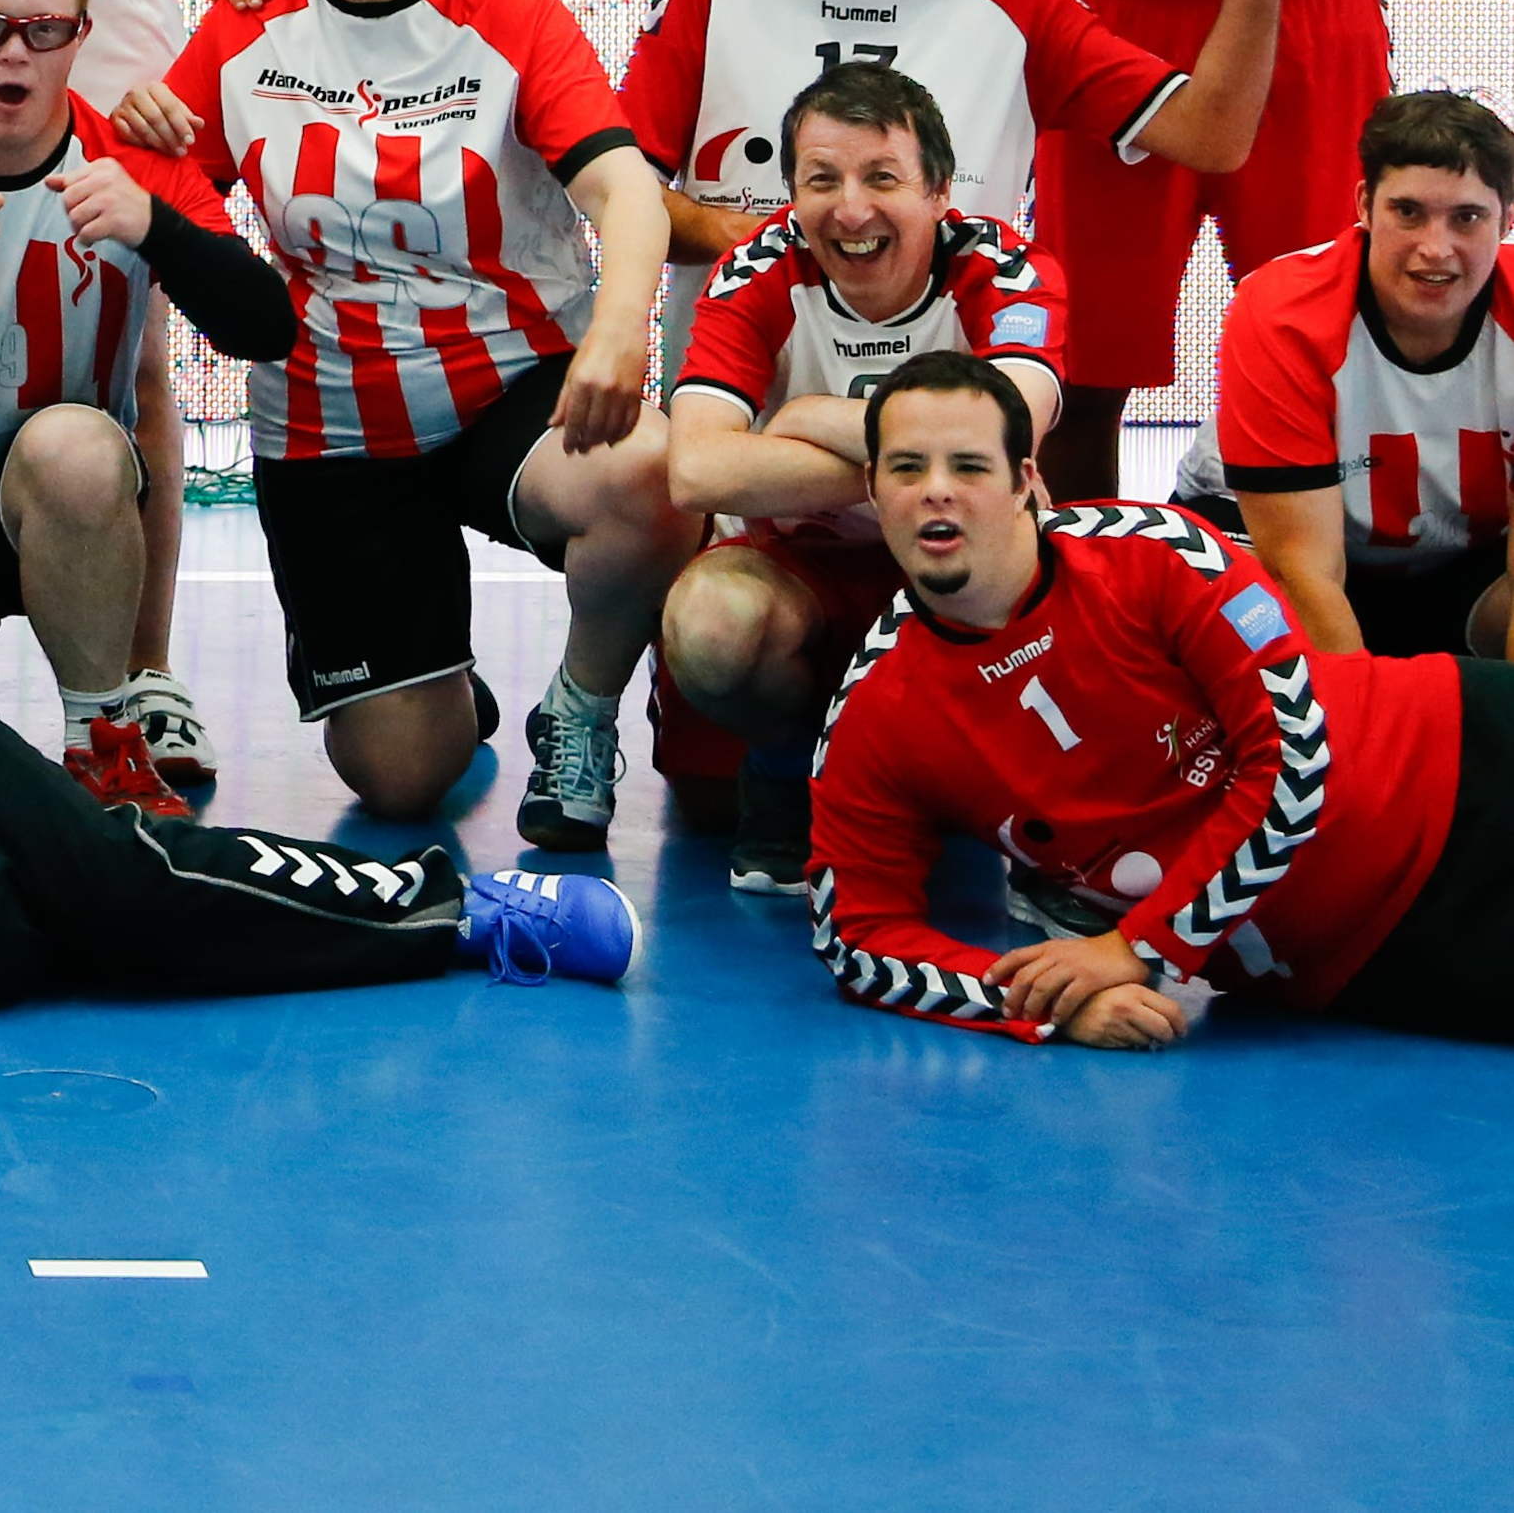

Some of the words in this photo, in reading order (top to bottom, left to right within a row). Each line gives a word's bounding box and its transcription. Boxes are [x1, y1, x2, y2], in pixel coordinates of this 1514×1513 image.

[821, 1, 898, 24] hummel
[834, 335, 912, 358] hummel
[313, 660, 370, 684] hummel
[978, 625, 1055, 687] hummel
[1018, 675, 1083, 752] 1
[1186, 744, 1223, 788] BSV
